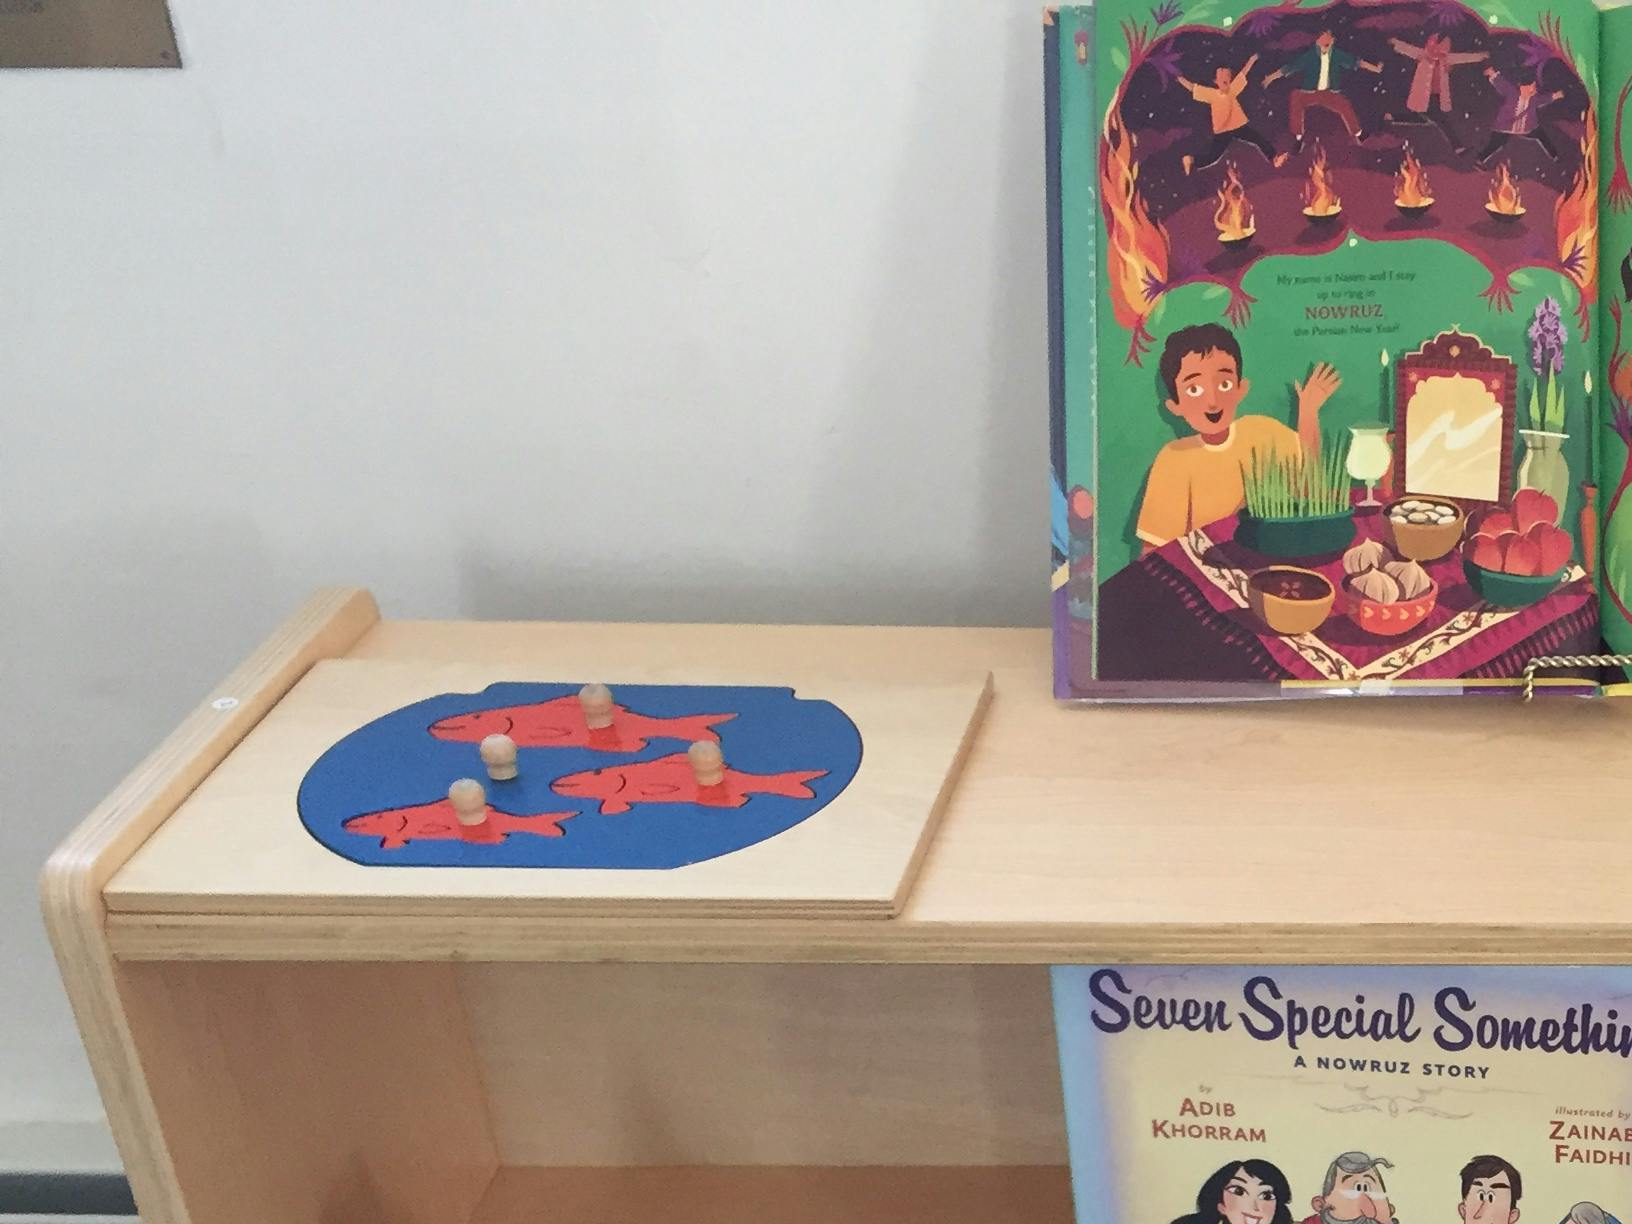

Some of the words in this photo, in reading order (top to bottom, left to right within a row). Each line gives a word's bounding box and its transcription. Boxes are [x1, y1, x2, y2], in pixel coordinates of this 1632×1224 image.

[1305, 304, 1384, 319] NOWRUZ
[1088, 967, 1232, 1034] Seven
[1238, 976, 1422, 1050] Special
[1293, 1056, 1307, 1069] A
[1317, 1057, 1411, 1075] NOWRUZ
[1422, 1062, 1490, 1079] STORY
[1199, 1084, 1212, 1094] by
[1555, 1106, 1613, 1118] illustrated
[1618, 1110, 1631, 1120] by
